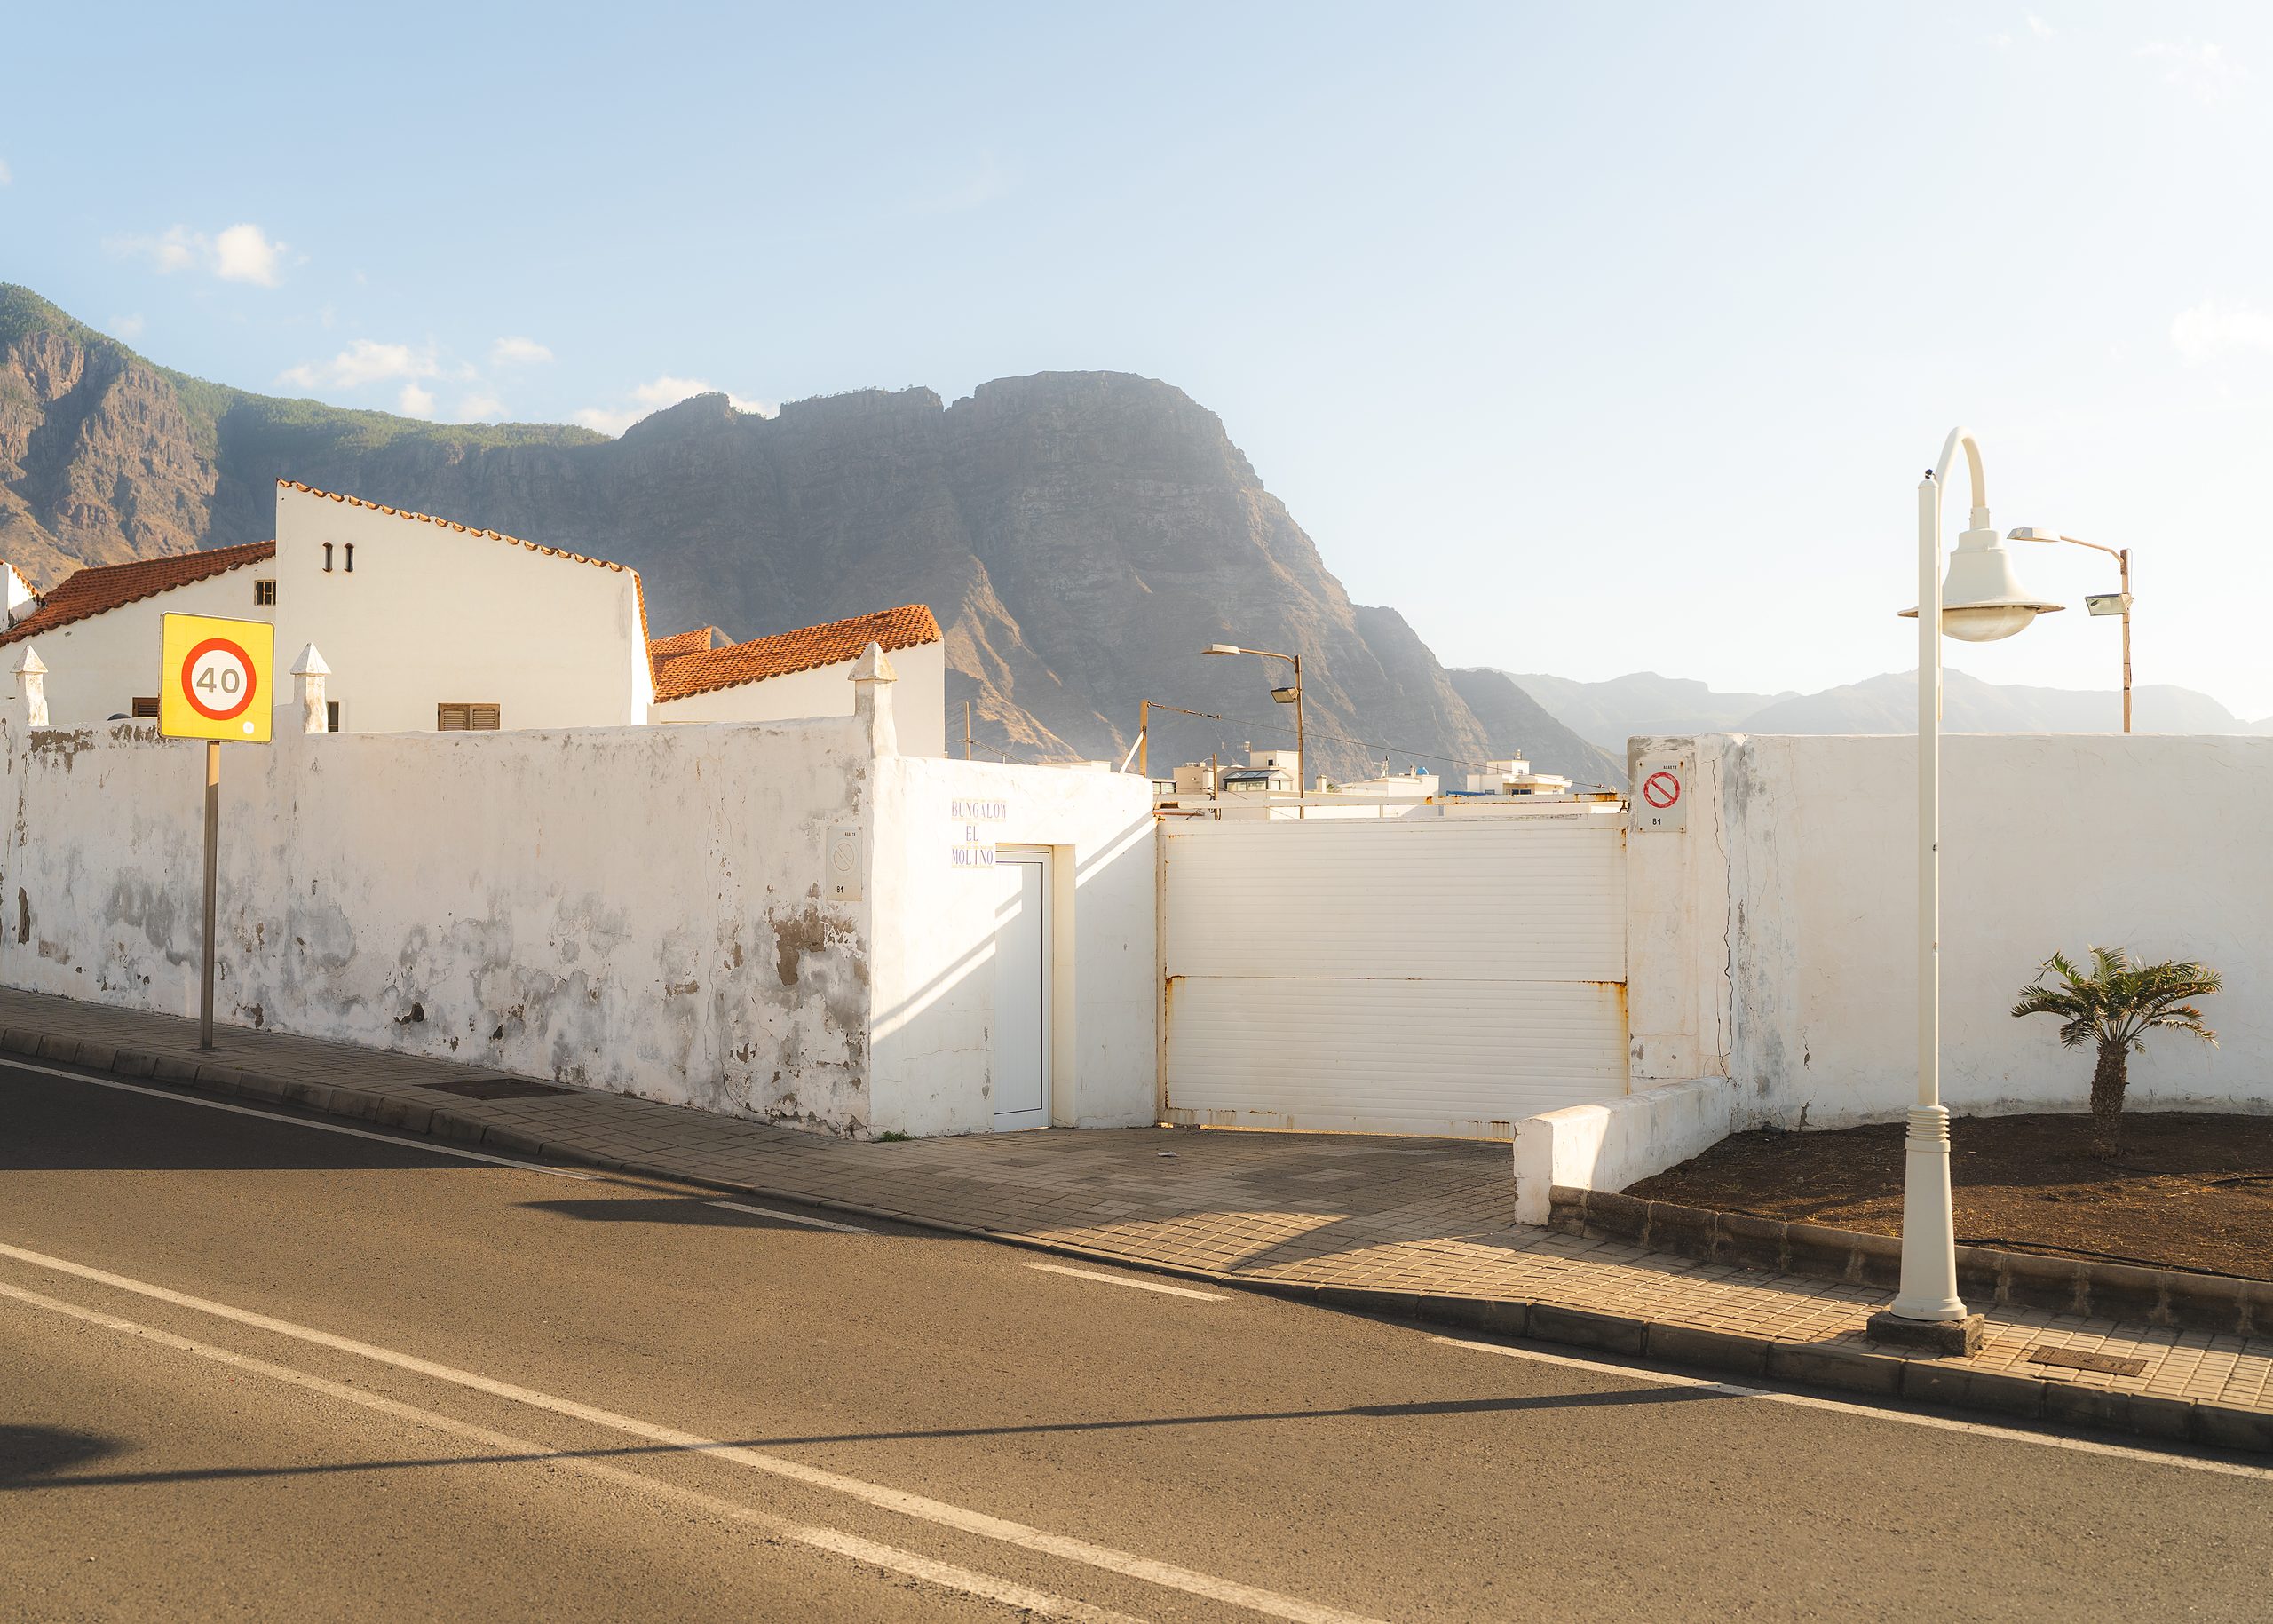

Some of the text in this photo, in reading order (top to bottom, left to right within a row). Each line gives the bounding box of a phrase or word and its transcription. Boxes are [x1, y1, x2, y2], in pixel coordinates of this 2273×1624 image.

[196, 667, 240, 693] 40
[952, 801, 1006, 819] BUNGALOW
[966, 825, 979, 841] EL
[952, 849, 994, 865] MOLINO
